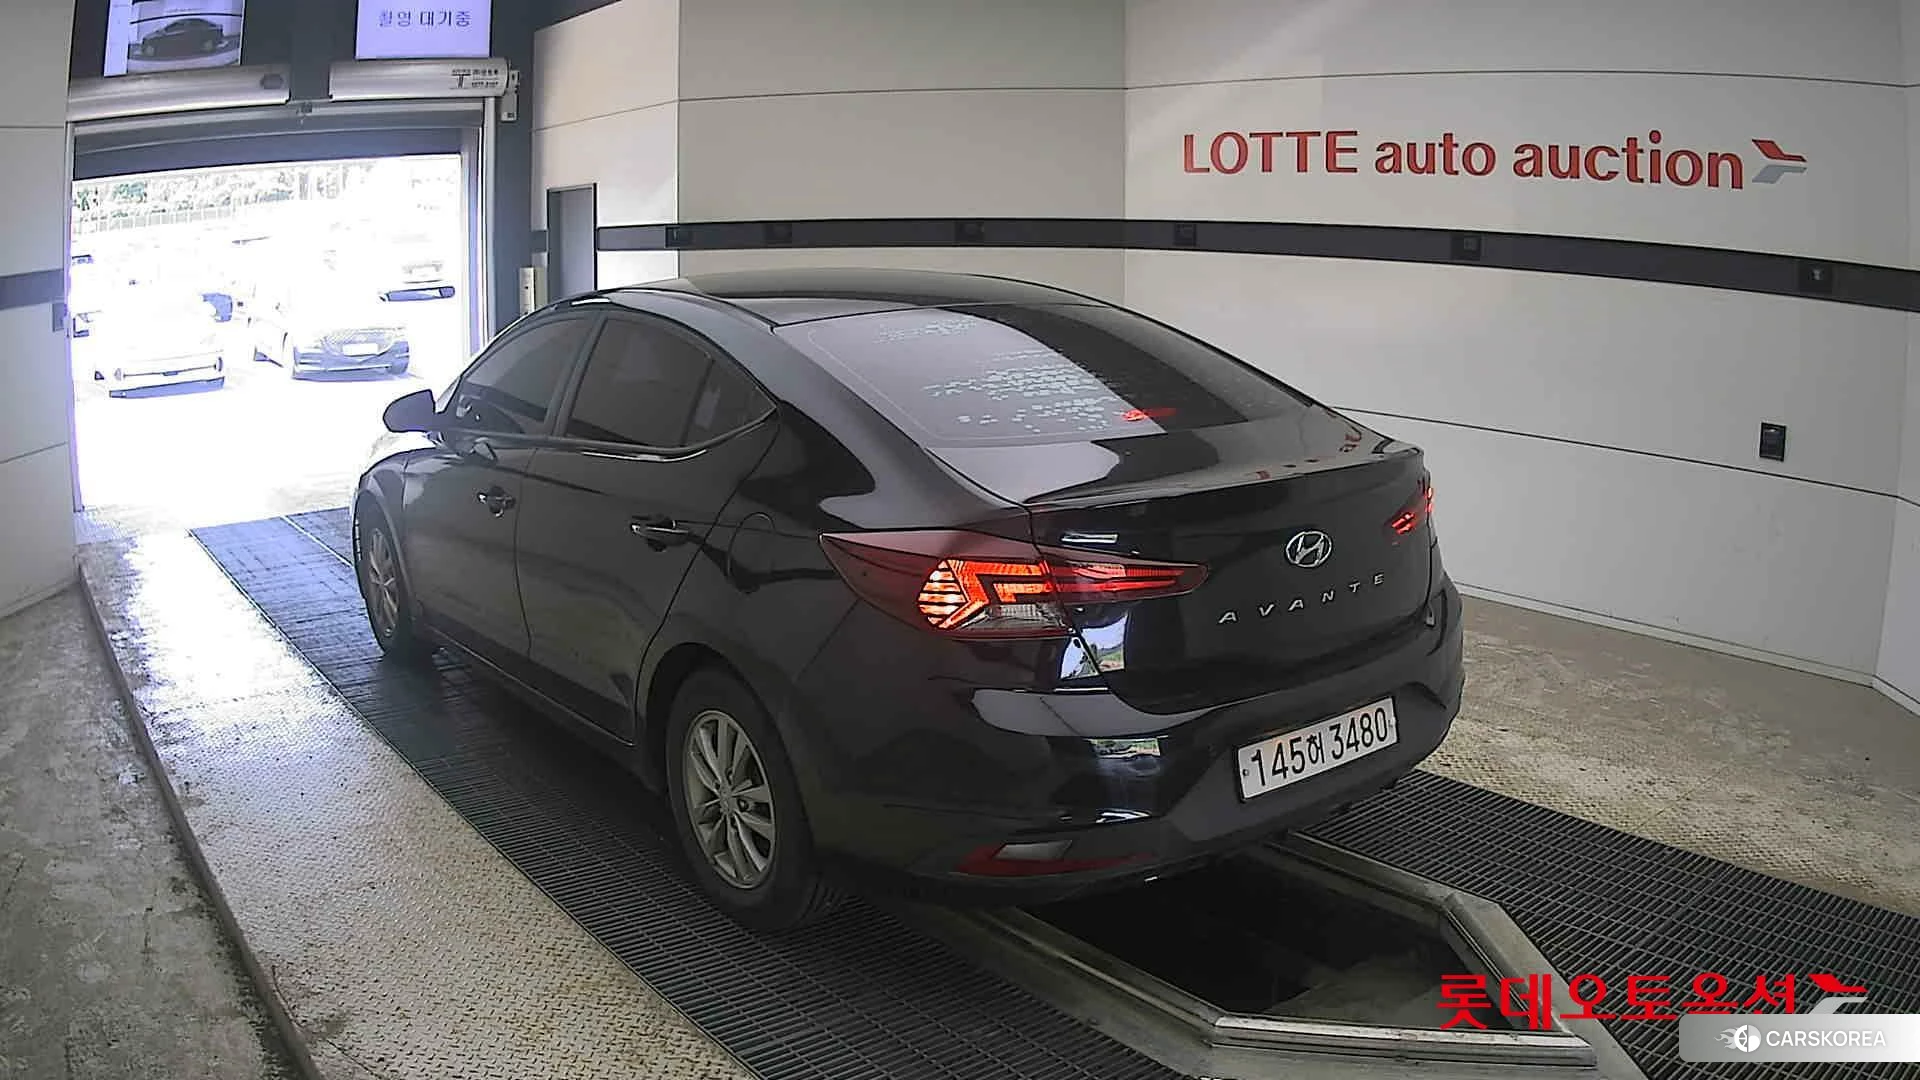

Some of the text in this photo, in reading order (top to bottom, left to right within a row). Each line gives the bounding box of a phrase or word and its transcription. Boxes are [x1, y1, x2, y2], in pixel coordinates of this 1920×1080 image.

[420, 10, 471, 27] 대기중
[1183, 130, 1744, 190] LOTTE auto auction
[1218, 573, 1384, 624] AVANTE
[1251, 707, 1388, 786] 145허 3480
